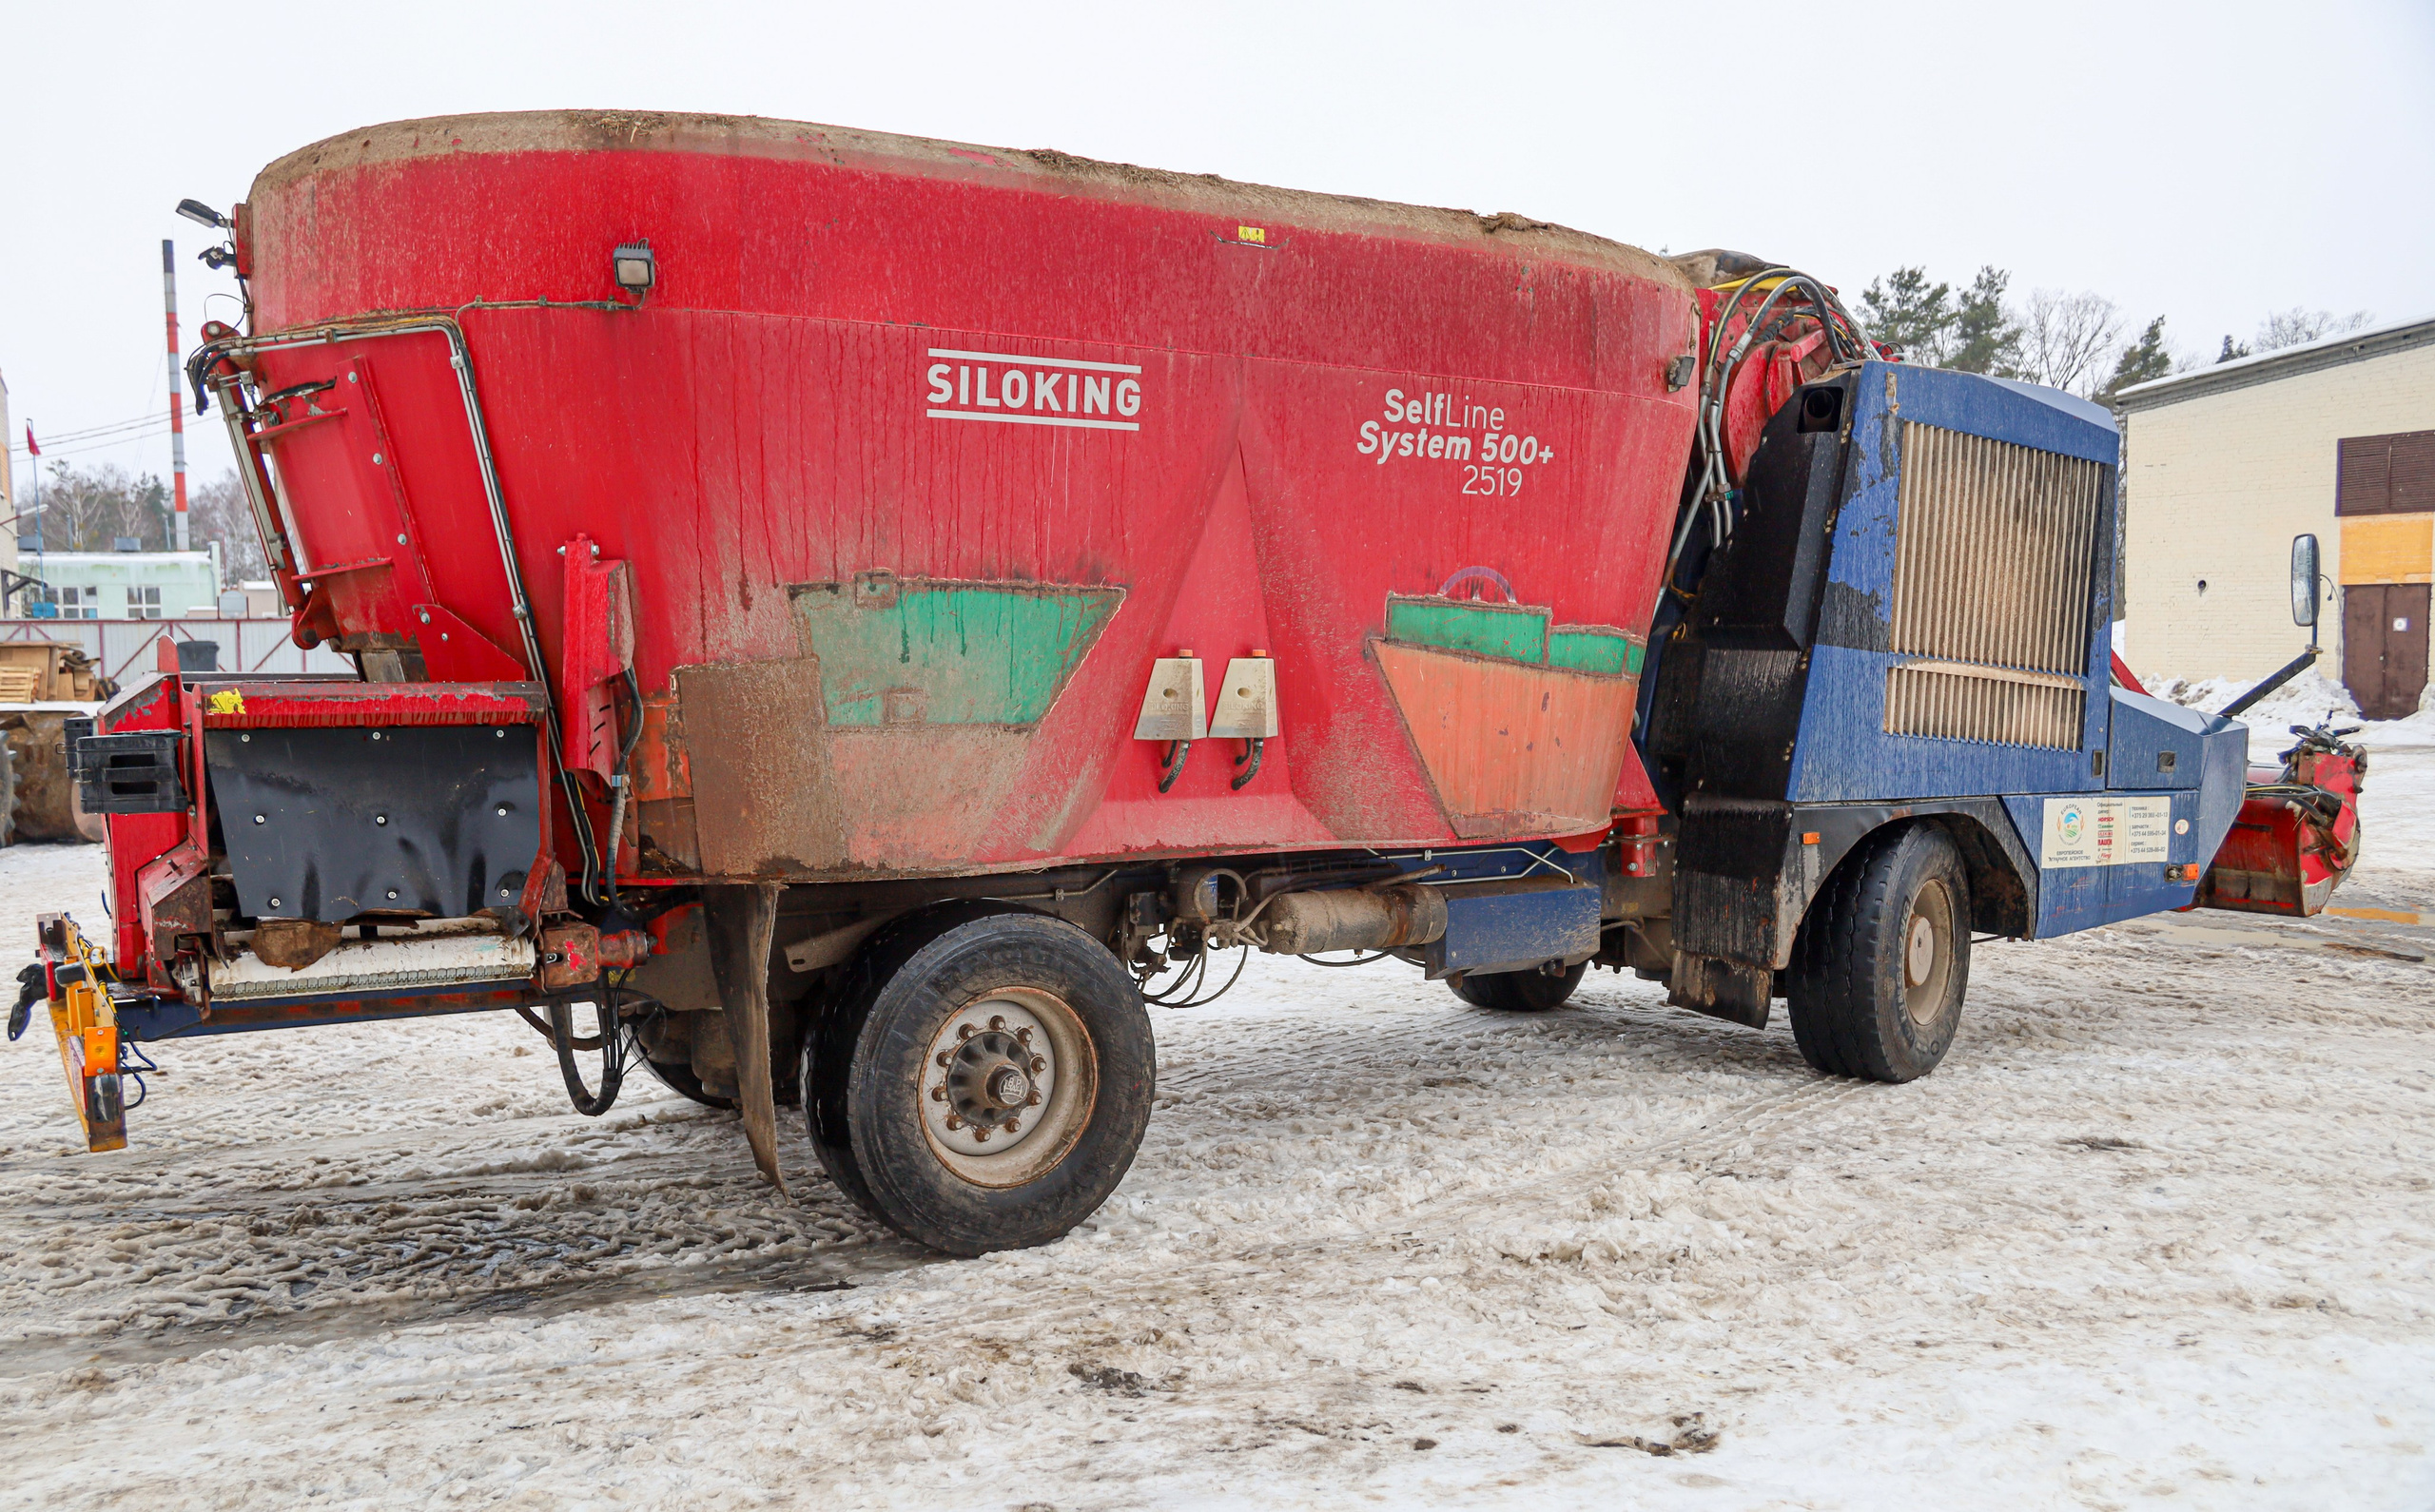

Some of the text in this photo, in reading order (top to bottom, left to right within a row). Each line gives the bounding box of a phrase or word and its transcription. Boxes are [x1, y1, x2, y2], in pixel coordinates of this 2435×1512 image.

[926, 363, 1141, 417] SILOKING
[1383, 389, 1505, 431] SelfLine
[1356, 420, 1554, 465] System 500+
[1462, 464, 1523, 496] 2519
[1148, 703, 1189, 711] SILOKING
[1222, 702, 1263, 710] SILOKING
[2060, 804, 2082, 815] EUROPEAN
